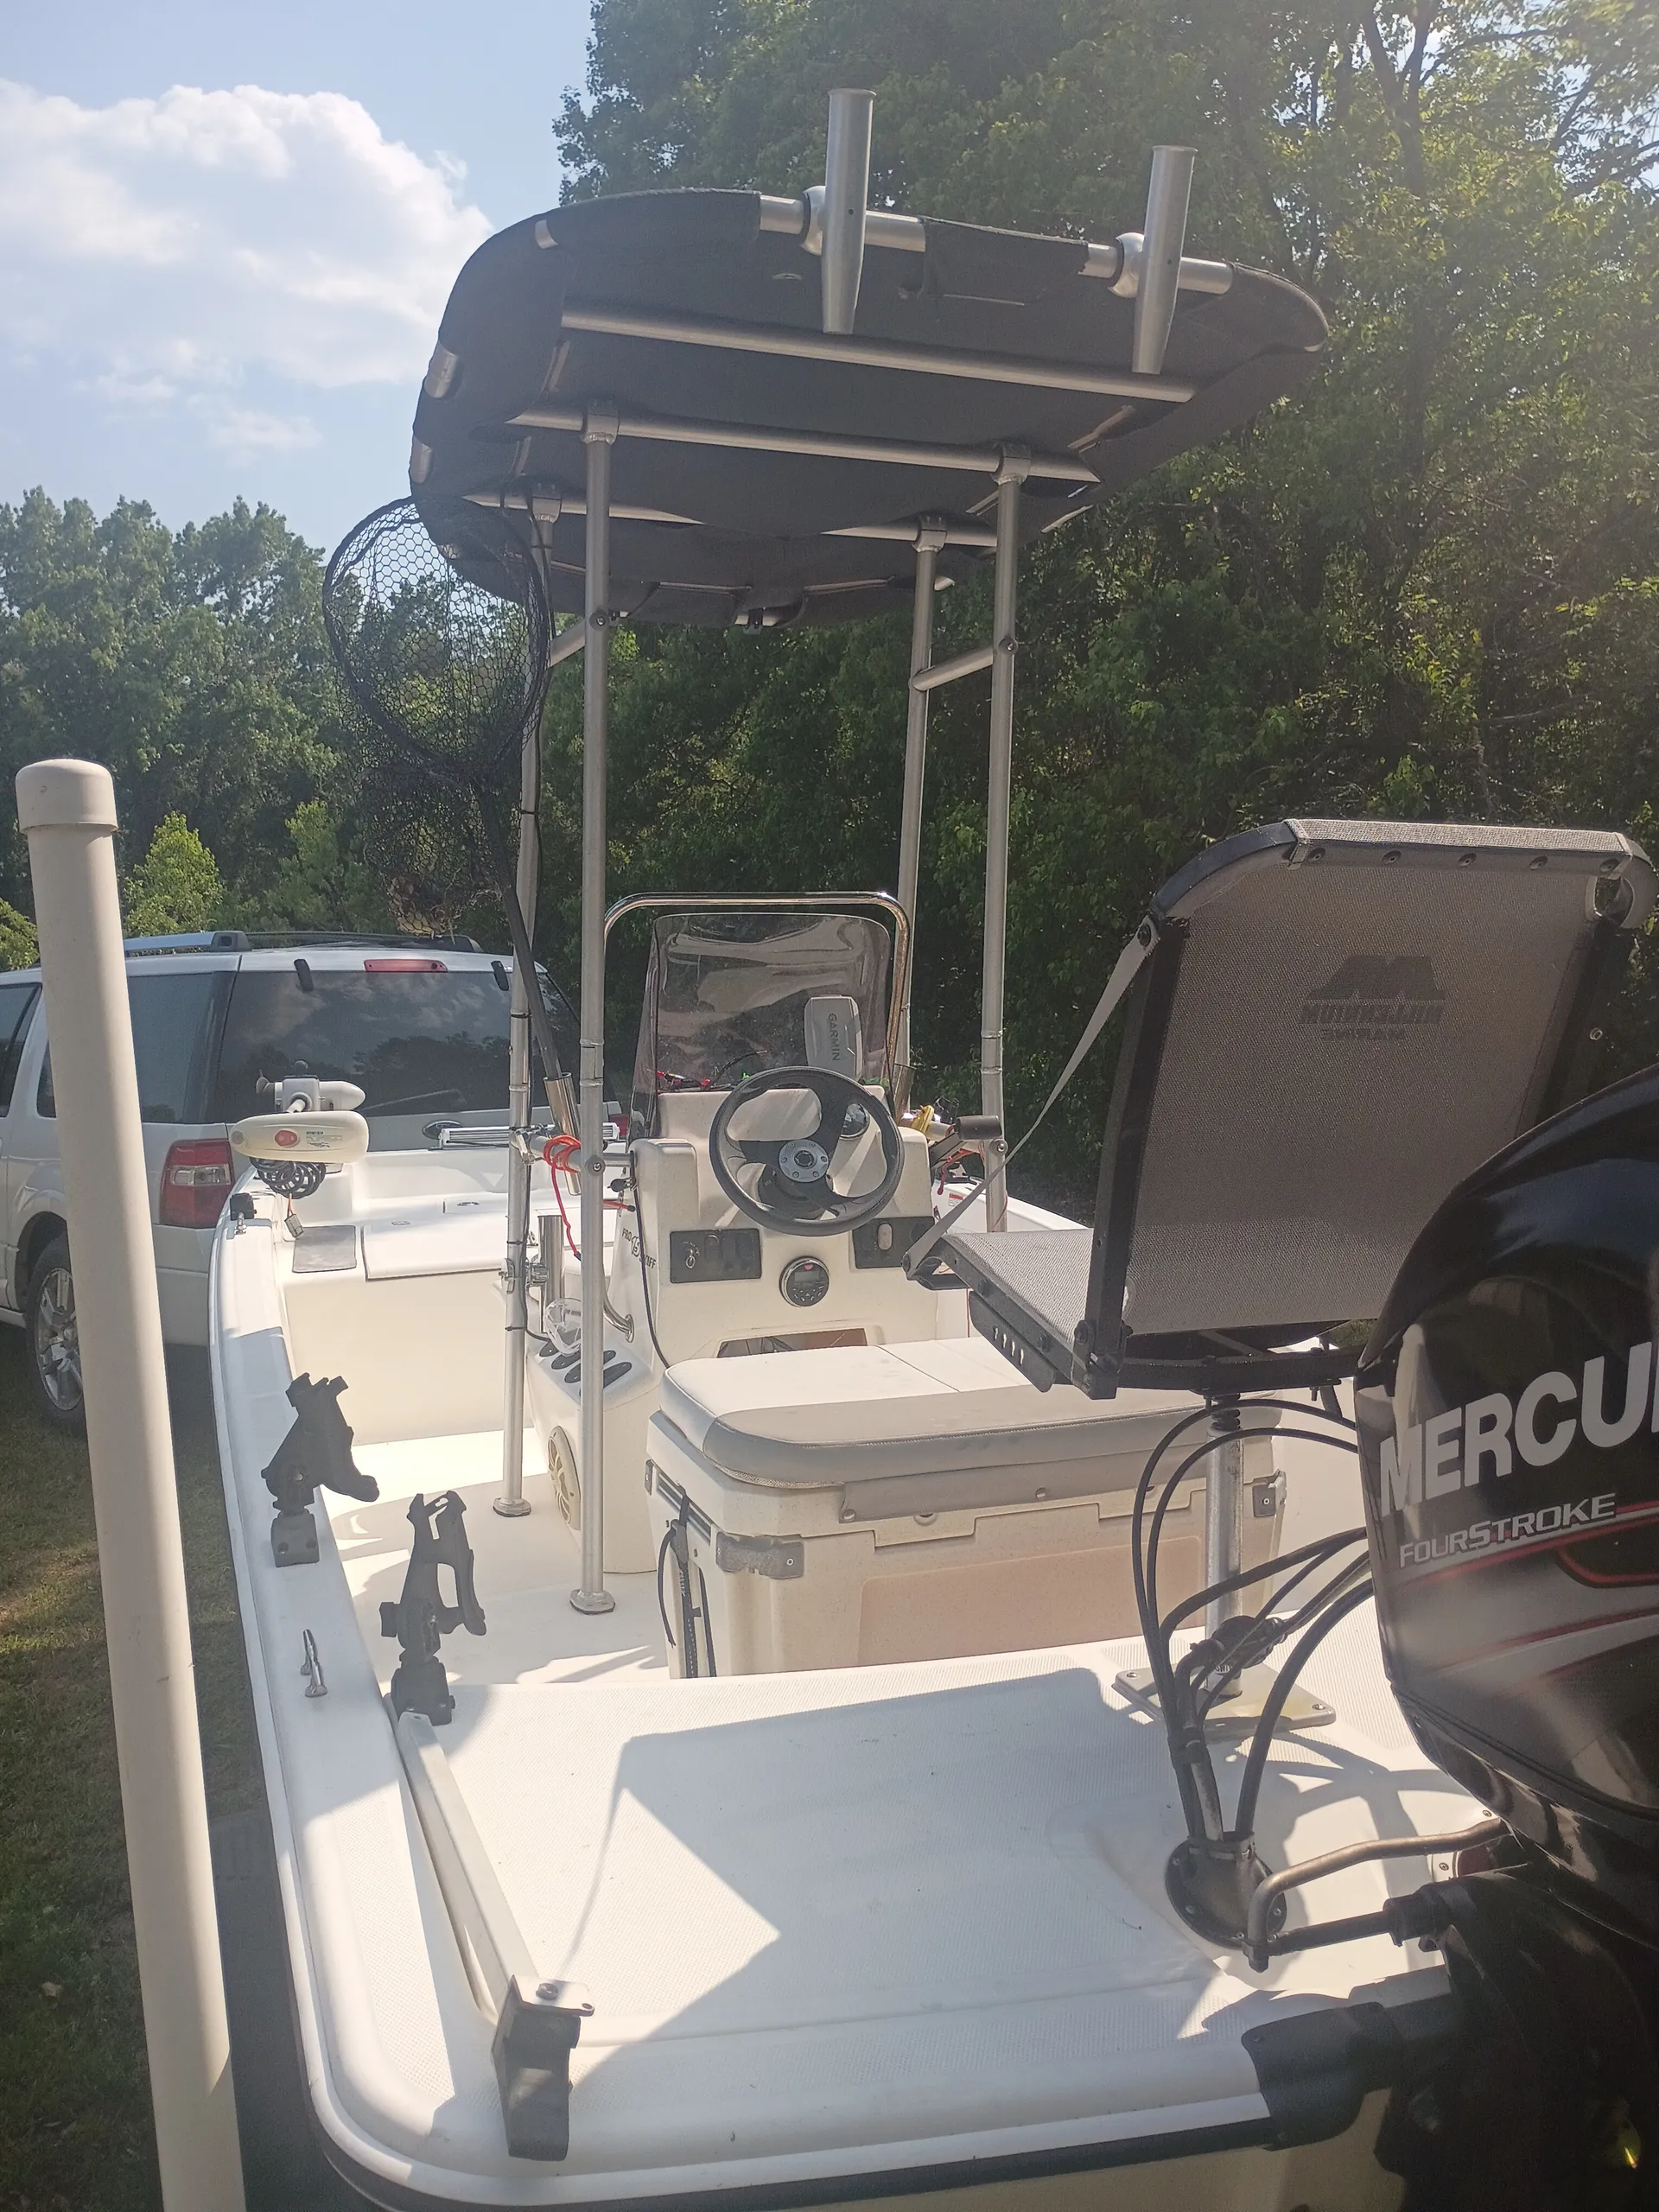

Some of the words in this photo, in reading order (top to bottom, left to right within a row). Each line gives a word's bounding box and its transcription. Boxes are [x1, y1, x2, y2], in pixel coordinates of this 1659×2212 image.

[828, 1013, 841, 1061] GARMIN
[621, 1228, 632, 1242] PRO
[1379, 1340, 1659, 1517] MERCU
[1399, 1491, 1617, 1568] FOURSTROKE
